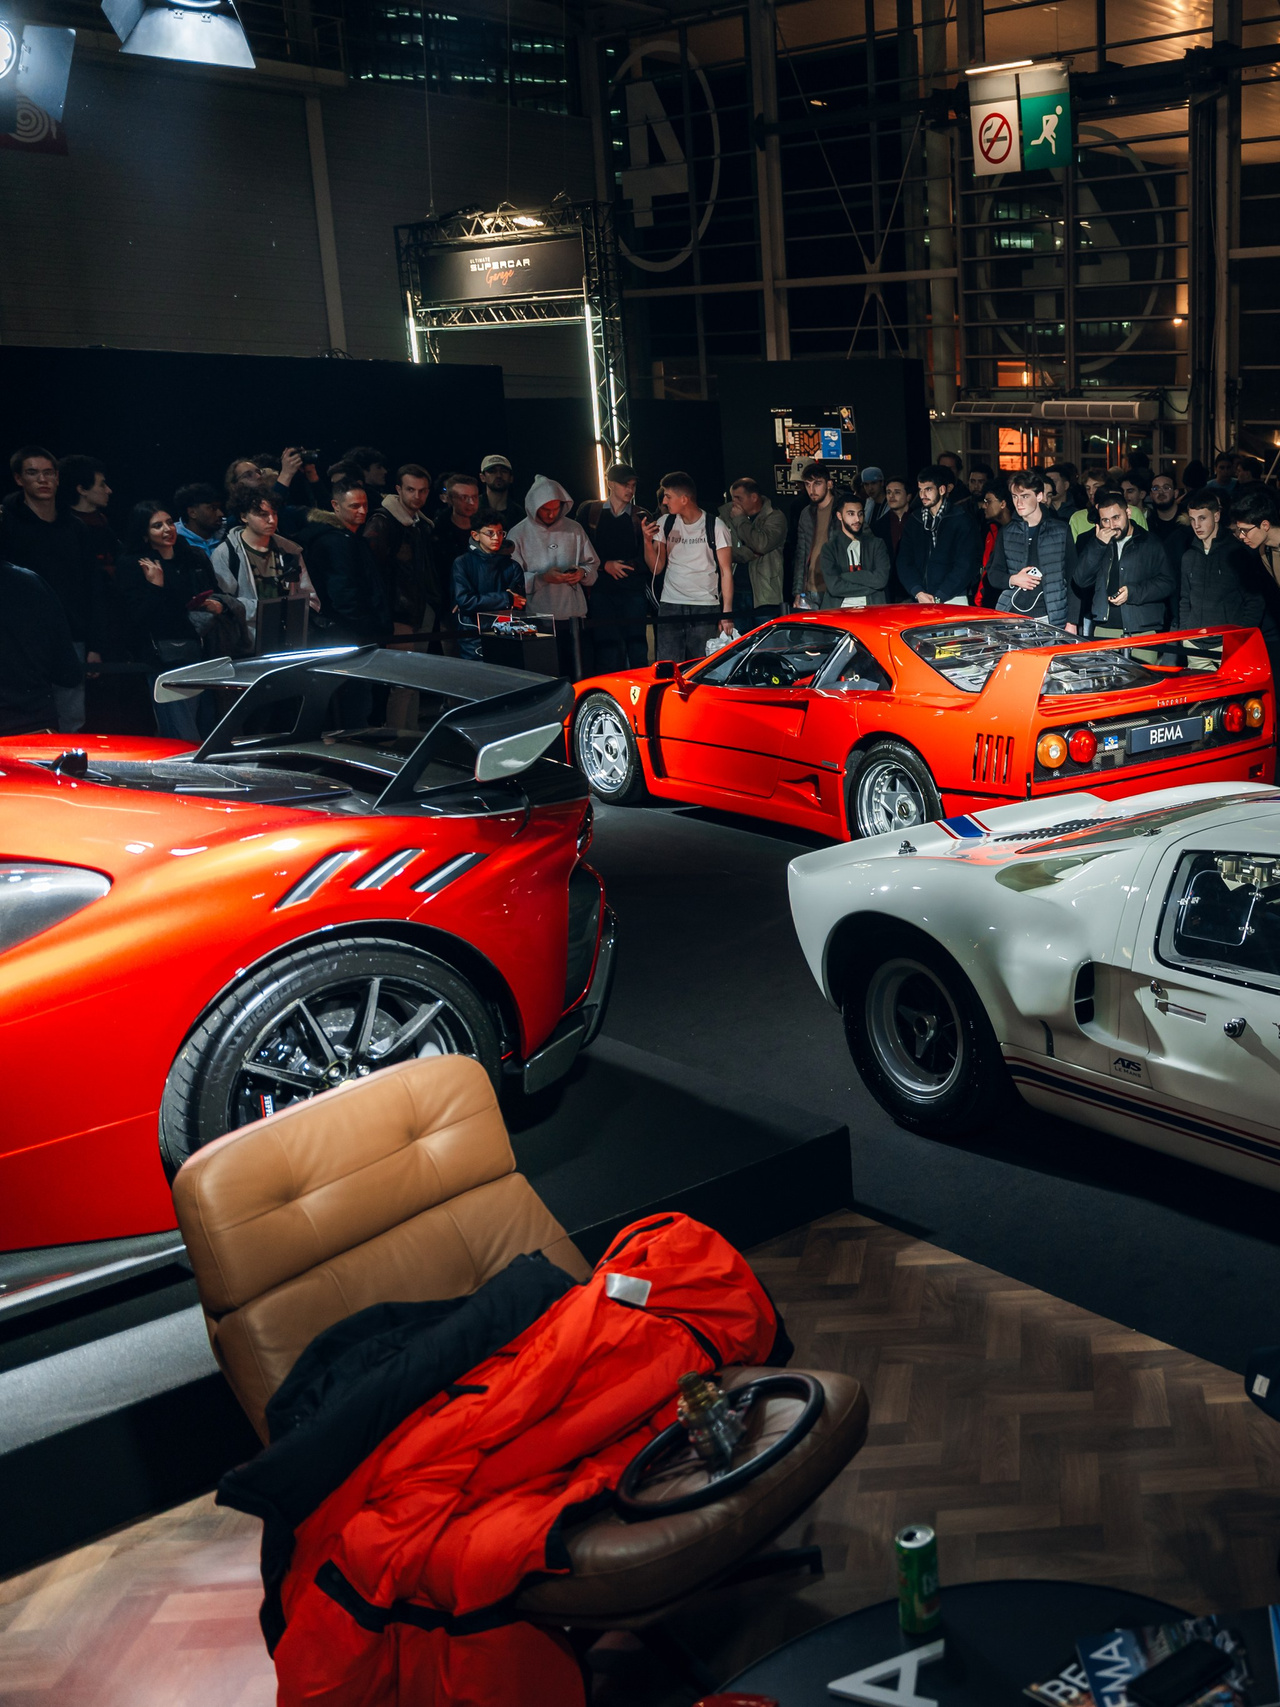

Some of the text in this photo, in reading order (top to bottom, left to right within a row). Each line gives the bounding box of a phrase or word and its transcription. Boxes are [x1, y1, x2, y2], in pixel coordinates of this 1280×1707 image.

[470, 258, 531, 272] SUPERCAR
[1149, 724, 1183, 745] BEMA
[240, 977, 303, 1035] MICHELIN
[1038, 1662, 1092, 1704] BE
[1089, 1636, 1137, 1707] EMA
